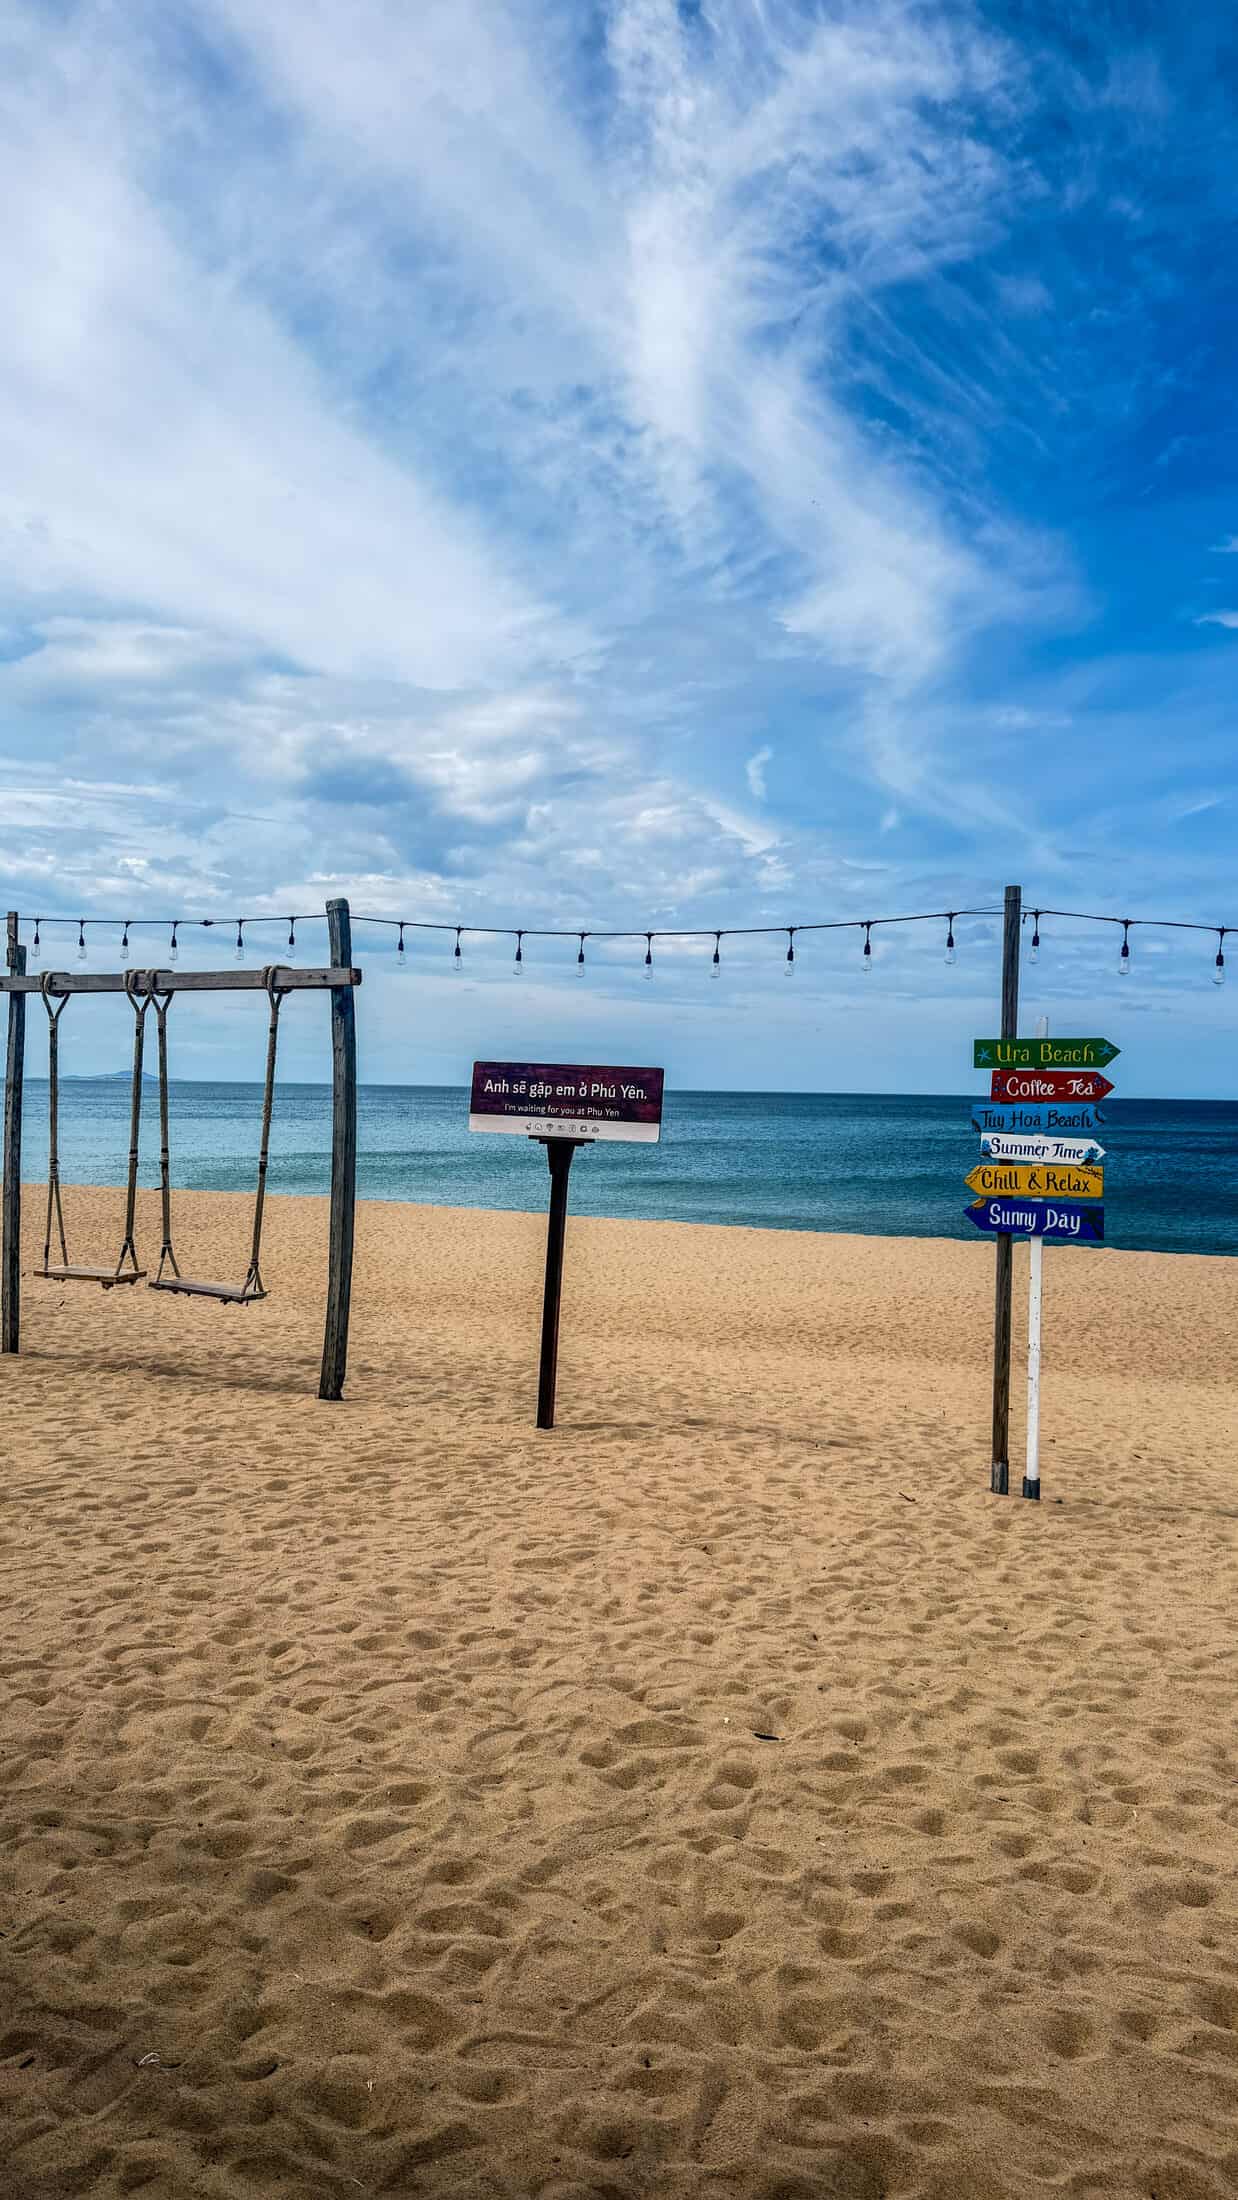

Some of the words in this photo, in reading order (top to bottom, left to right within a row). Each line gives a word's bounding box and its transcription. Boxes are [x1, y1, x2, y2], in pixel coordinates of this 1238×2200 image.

[996, 1044, 1030, 1062] Ura
[1040, 1043, 1095, 1062] Beach
[484, 1080, 509, 1093] Anh
[512, 1081, 526, 1094] sẽ
[529, 1082, 552, 1100] gặp
[556, 1084, 575, 1095] em
[579, 1081, 587, 1096] ở
[591, 1082, 616, 1098] Phú
[620, 1084, 647, 1100] Yên.
[1006, 1077, 1055, 1096] Coffee
[1068, 1079, 1095, 1095] Tea
[518, 1104, 545, 1114] waiting
[547, 1105, 559, 1113] for
[560, 1107, 574, 1116] you
[576, 1107, 585, 1115] at
[587, 1108, 602, 1117] Phu
[605, 1108, 620, 1117] Yen
[979, 1110, 1006, 1130] Tuy
[1010, 1111, 1041, 1129] Hoa
[1046, 1110, 1092, 1129] Beach
[989, 1138, 1049, 1157] Summer
[1052, 1143, 1084, 1159] Time
[981, 1171, 1021, 1190] Chill
[1028, 1173, 1042, 1190] &
[1046, 1172, 1091, 1192] Relax
[989, 1203, 1037, 1231] Sunny
[1043, 1209, 1081, 1234] Day
